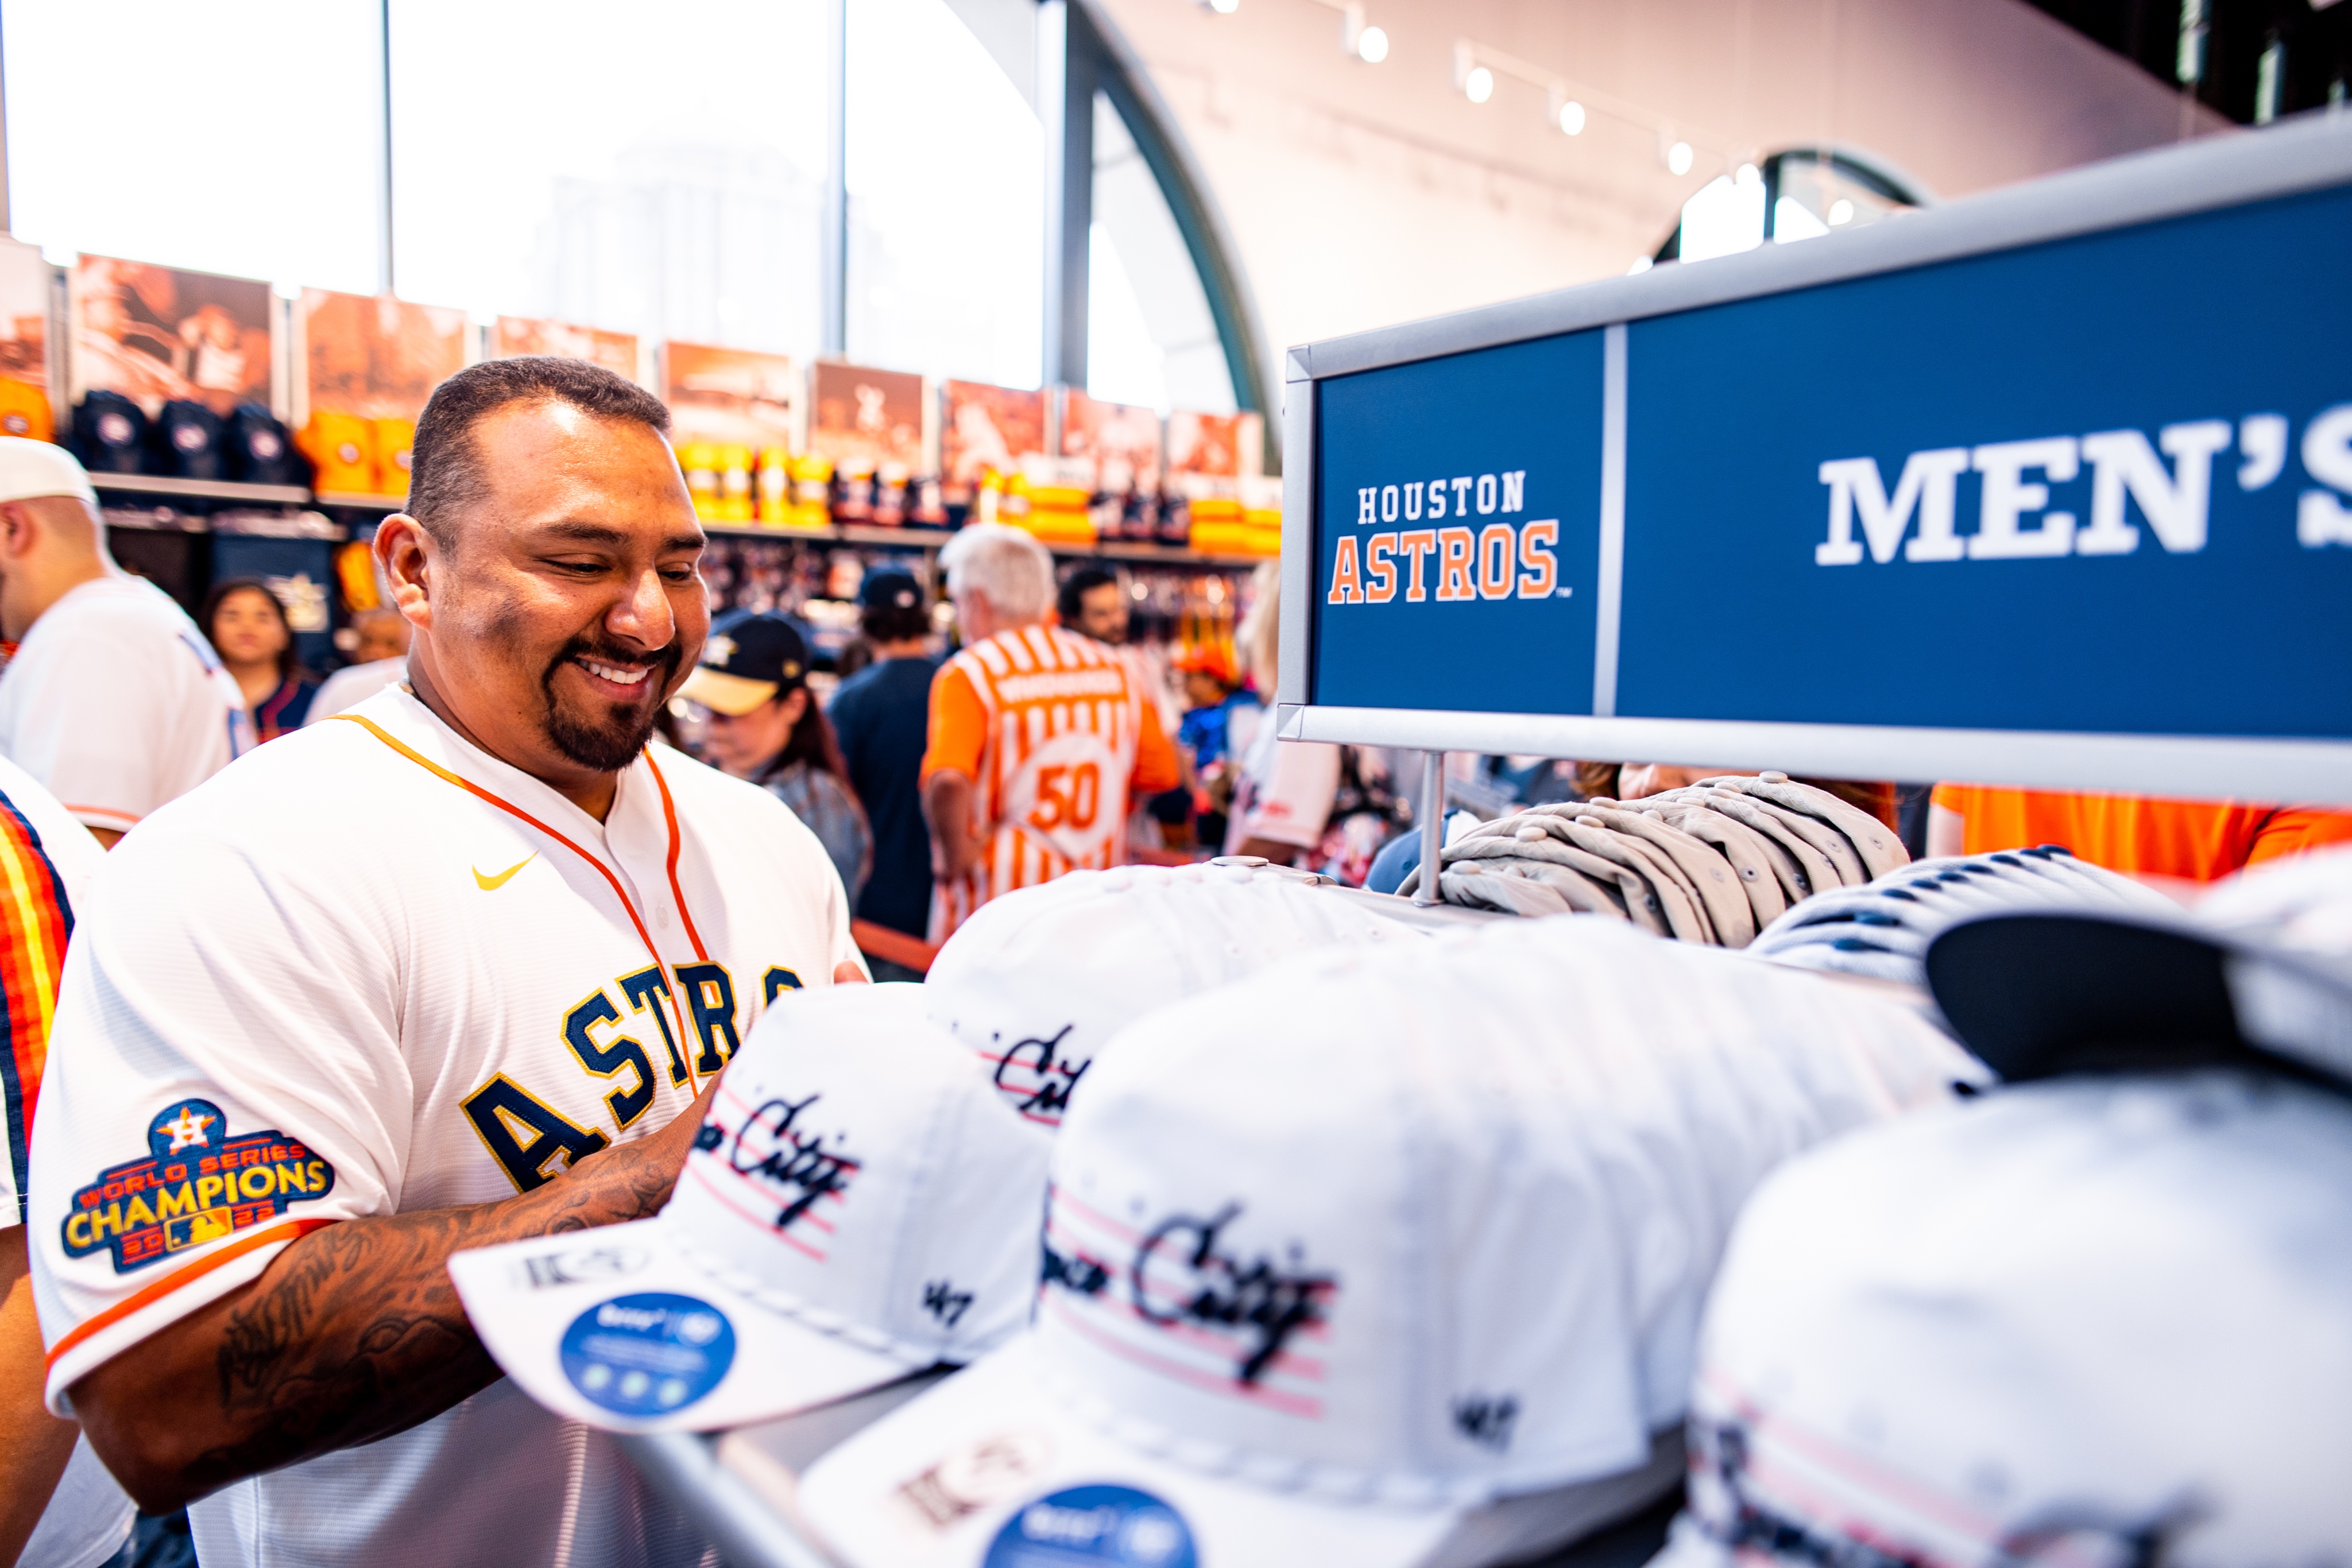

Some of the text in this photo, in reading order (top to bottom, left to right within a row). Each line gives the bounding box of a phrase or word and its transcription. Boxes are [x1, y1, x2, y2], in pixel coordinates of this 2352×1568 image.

[1358, 470, 1526, 524] HOUSTON
[1328, 518, 1559, 604] ASTROS
[1032, 762, 1100, 830] 50
[66, 1160, 327, 1249] CHAMPIONS
[78, 1144, 306, 1210] WORLD SERIES
